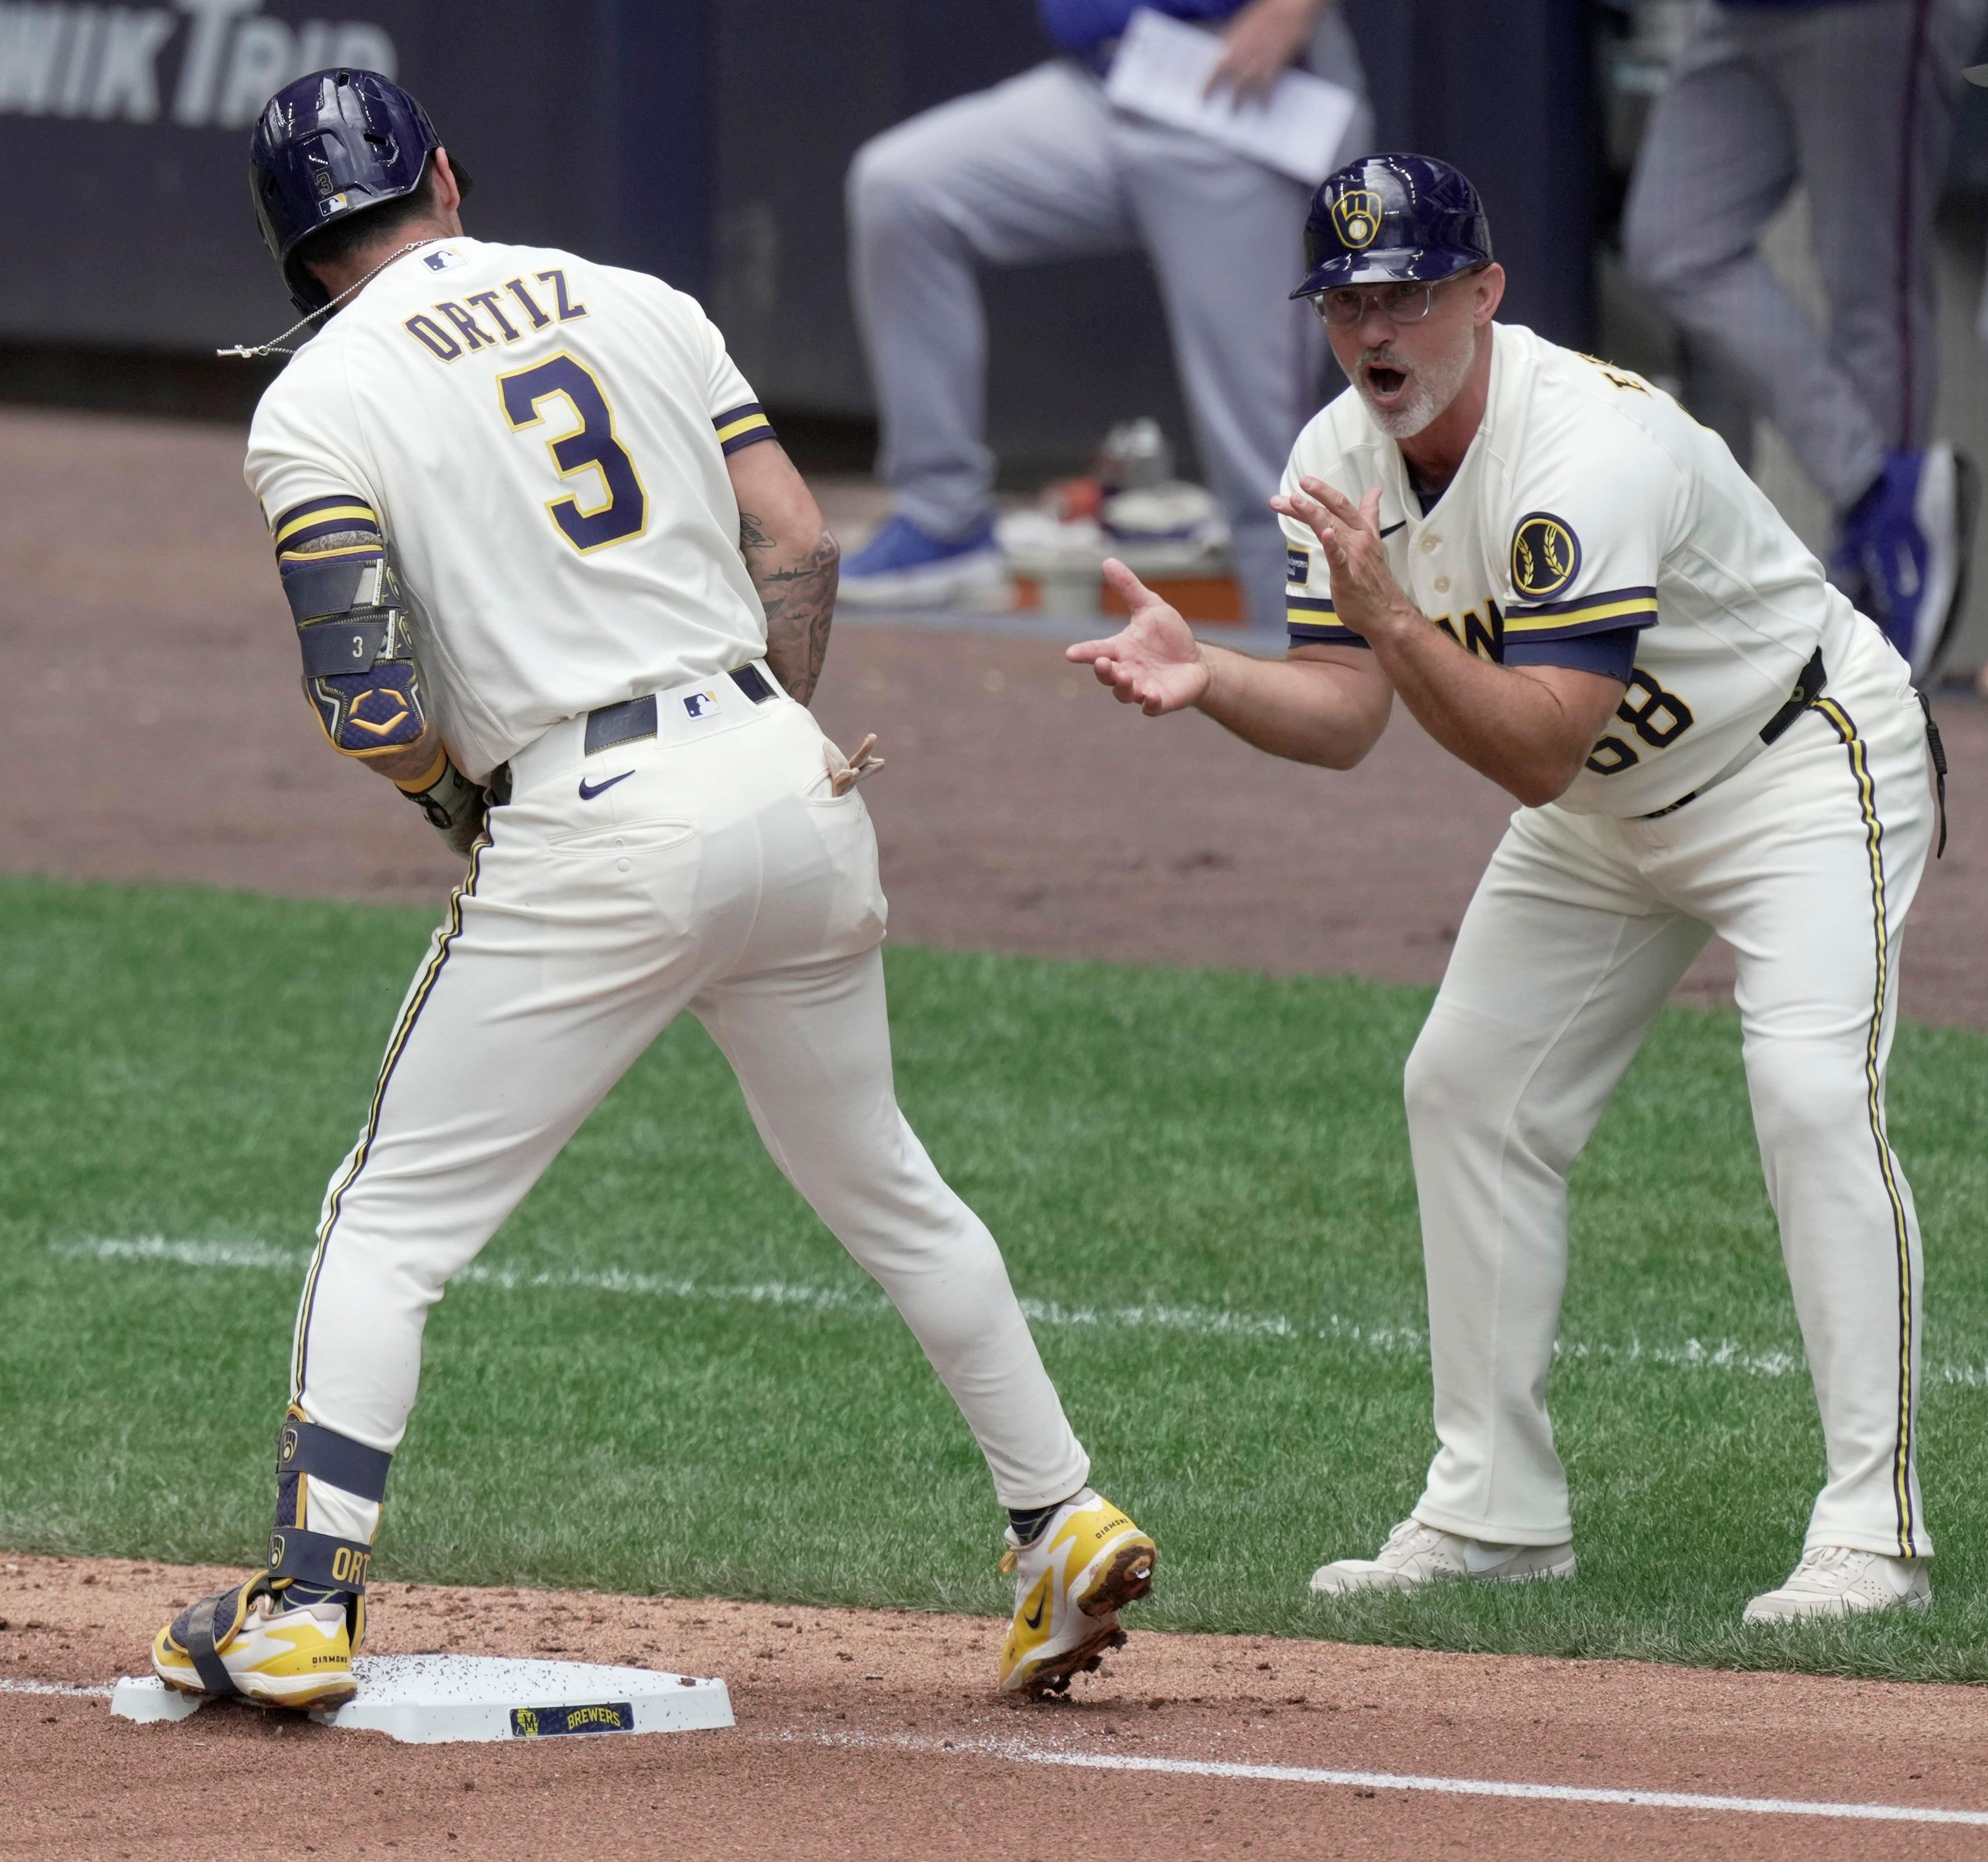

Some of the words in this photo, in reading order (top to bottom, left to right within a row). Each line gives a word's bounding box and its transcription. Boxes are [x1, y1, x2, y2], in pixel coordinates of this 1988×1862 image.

[316, 171, 334, 196] 3
[401, 268, 590, 364] ORTIZ
[495, 349, 649, 557] 3
[352, 636, 363, 658] 3
[312, 1655, 347, 1664] DIAMOND
[567, 1707, 621, 1730] BREWERS
